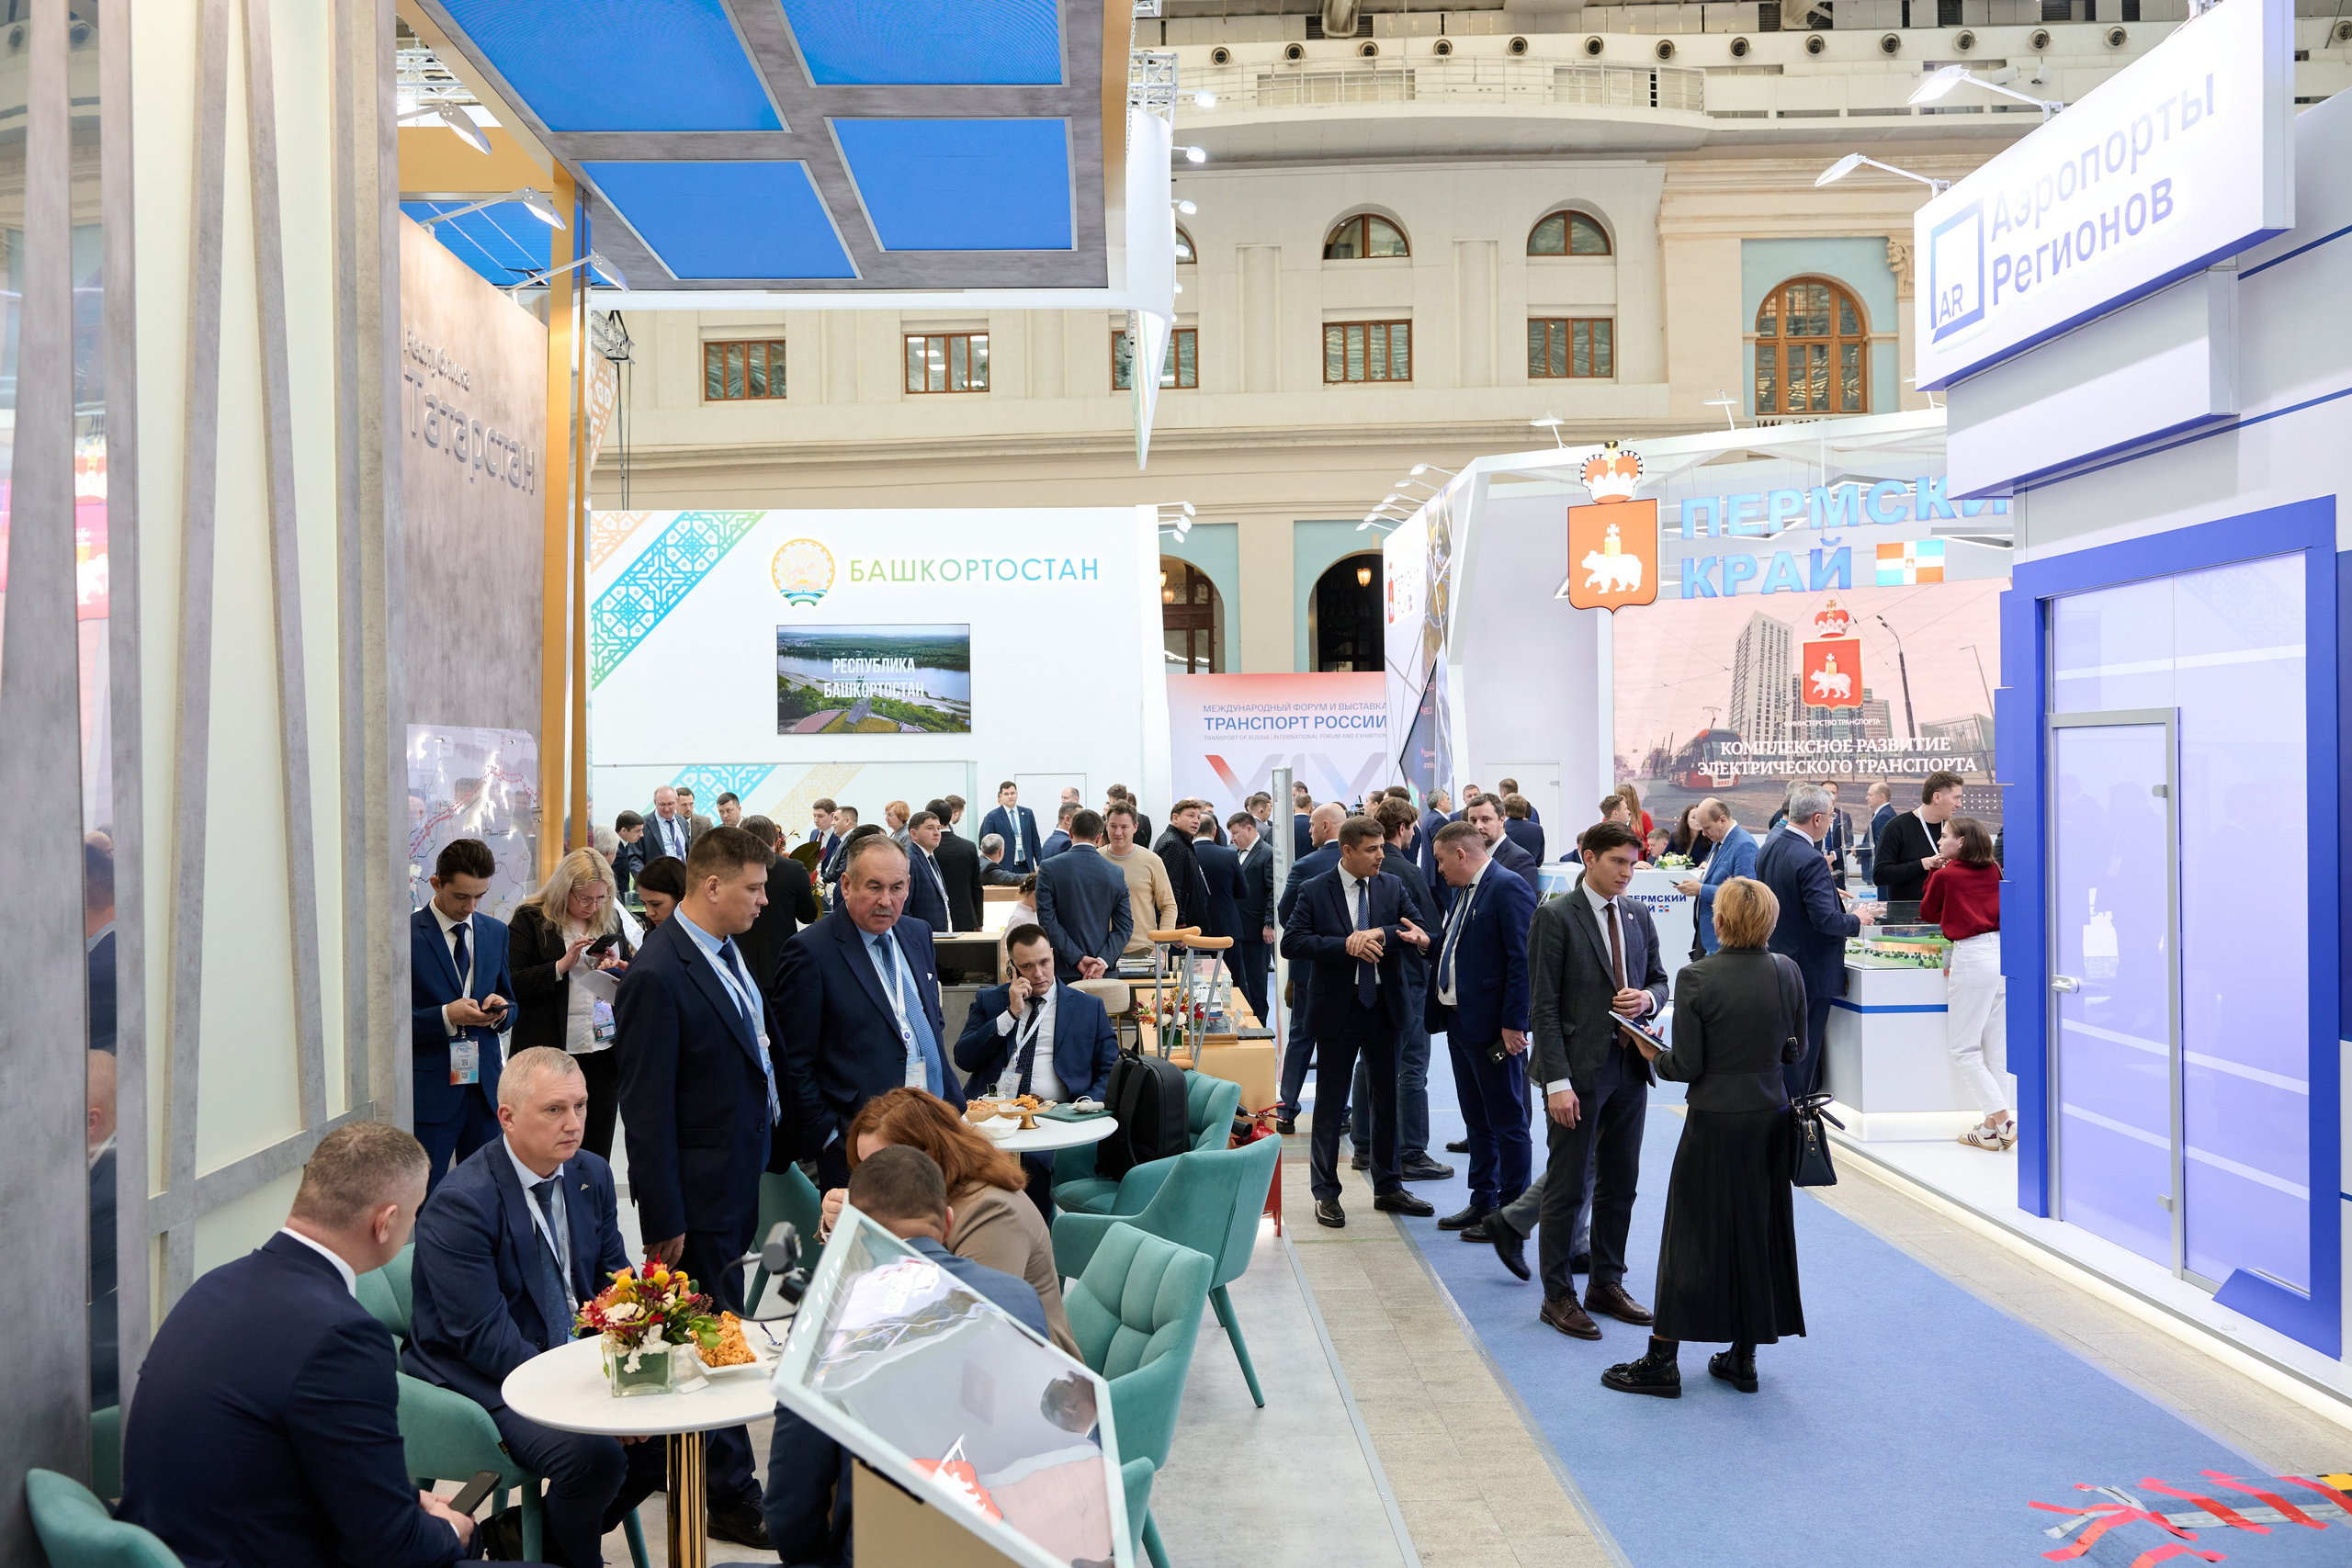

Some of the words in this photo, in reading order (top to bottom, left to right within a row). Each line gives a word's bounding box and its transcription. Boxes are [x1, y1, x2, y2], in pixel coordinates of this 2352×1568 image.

[1991, 73, 2214, 243] Аэропорты
[1993, 177, 2174, 307] Регионов
[1939, 283, 1963, 323] AR
[404, 365, 536, 491] Татарстан
[850, 558, 1099, 582] БАШКОРТОСТАН
[1681, 536, 1852, 600] КРАЙ
[832, 657, 916, 673] РЕСПУБЛИКА
[823, 682, 924, 698] БАШКОРТОСТАН
[1204, 703, 1291, 713] МЕЖДУНАРОДНЫЙ
[1293, 703, 1328, 712] ФОРУМ
[1330, 703, 1337, 711] И
[1339, 702, 1386, 711] ВЫСТАВКА
[1204, 716, 1310, 730] ТРАНСПОРТ
[1314, 715, 1387, 729] РОССИИ
[1720, 738, 1853, 756] КОМПЛЕКСНОЕ
[1857, 736, 1951, 753] РАЗВИТИЕ
[1697, 760, 1853, 776] ЭЛЕКТРИЧЕСКОГО
[1855, 757, 1977, 774] ТРАНСПОРТА
